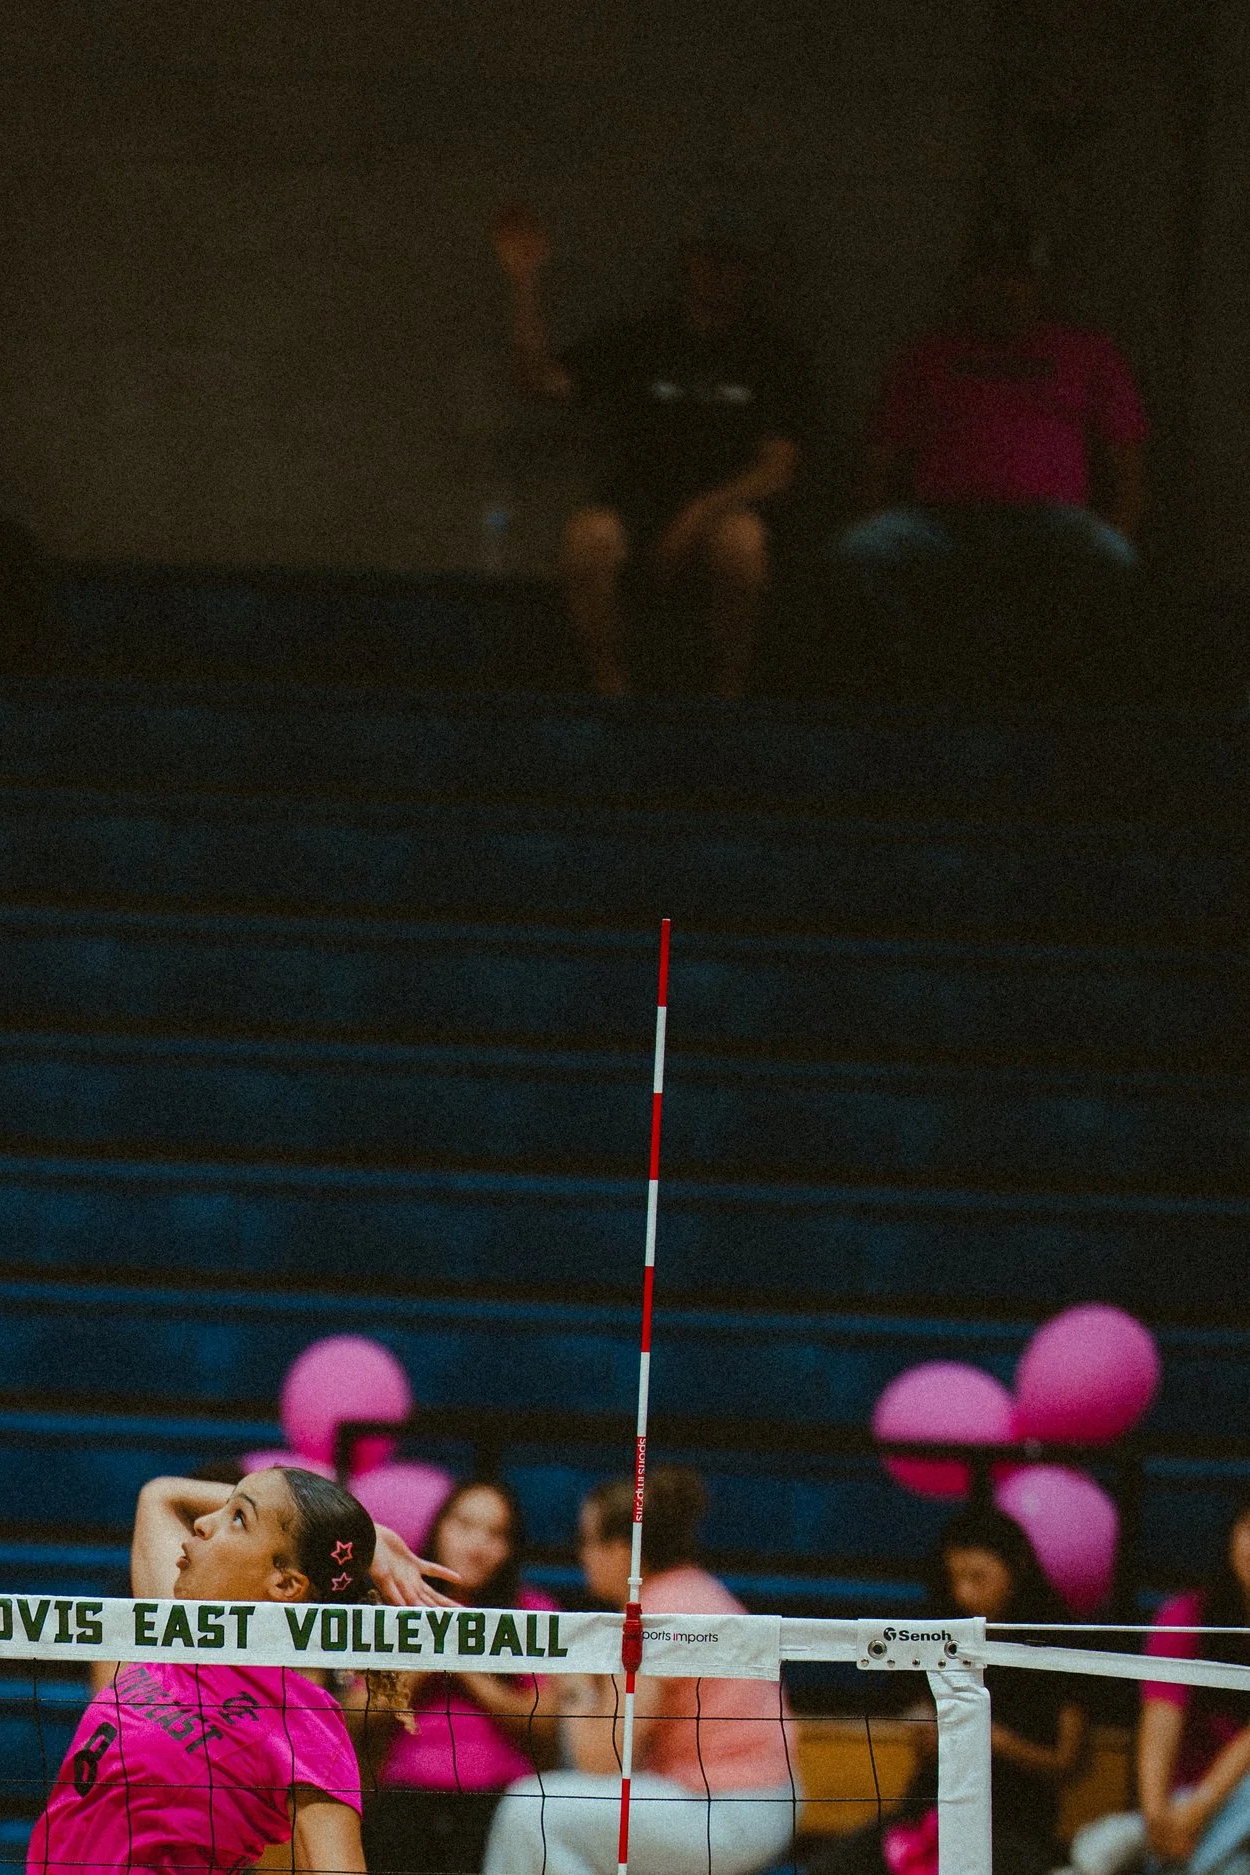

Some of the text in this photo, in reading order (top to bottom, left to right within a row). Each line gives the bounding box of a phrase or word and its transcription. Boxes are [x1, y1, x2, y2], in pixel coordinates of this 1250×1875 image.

[132, 1603, 255, 1650] EAST
[282, 1607, 569, 1658] VOLLEYBALL
[898, 1630, 952, 1641] Senoh
[642, 1631, 719, 1645] ports imports
